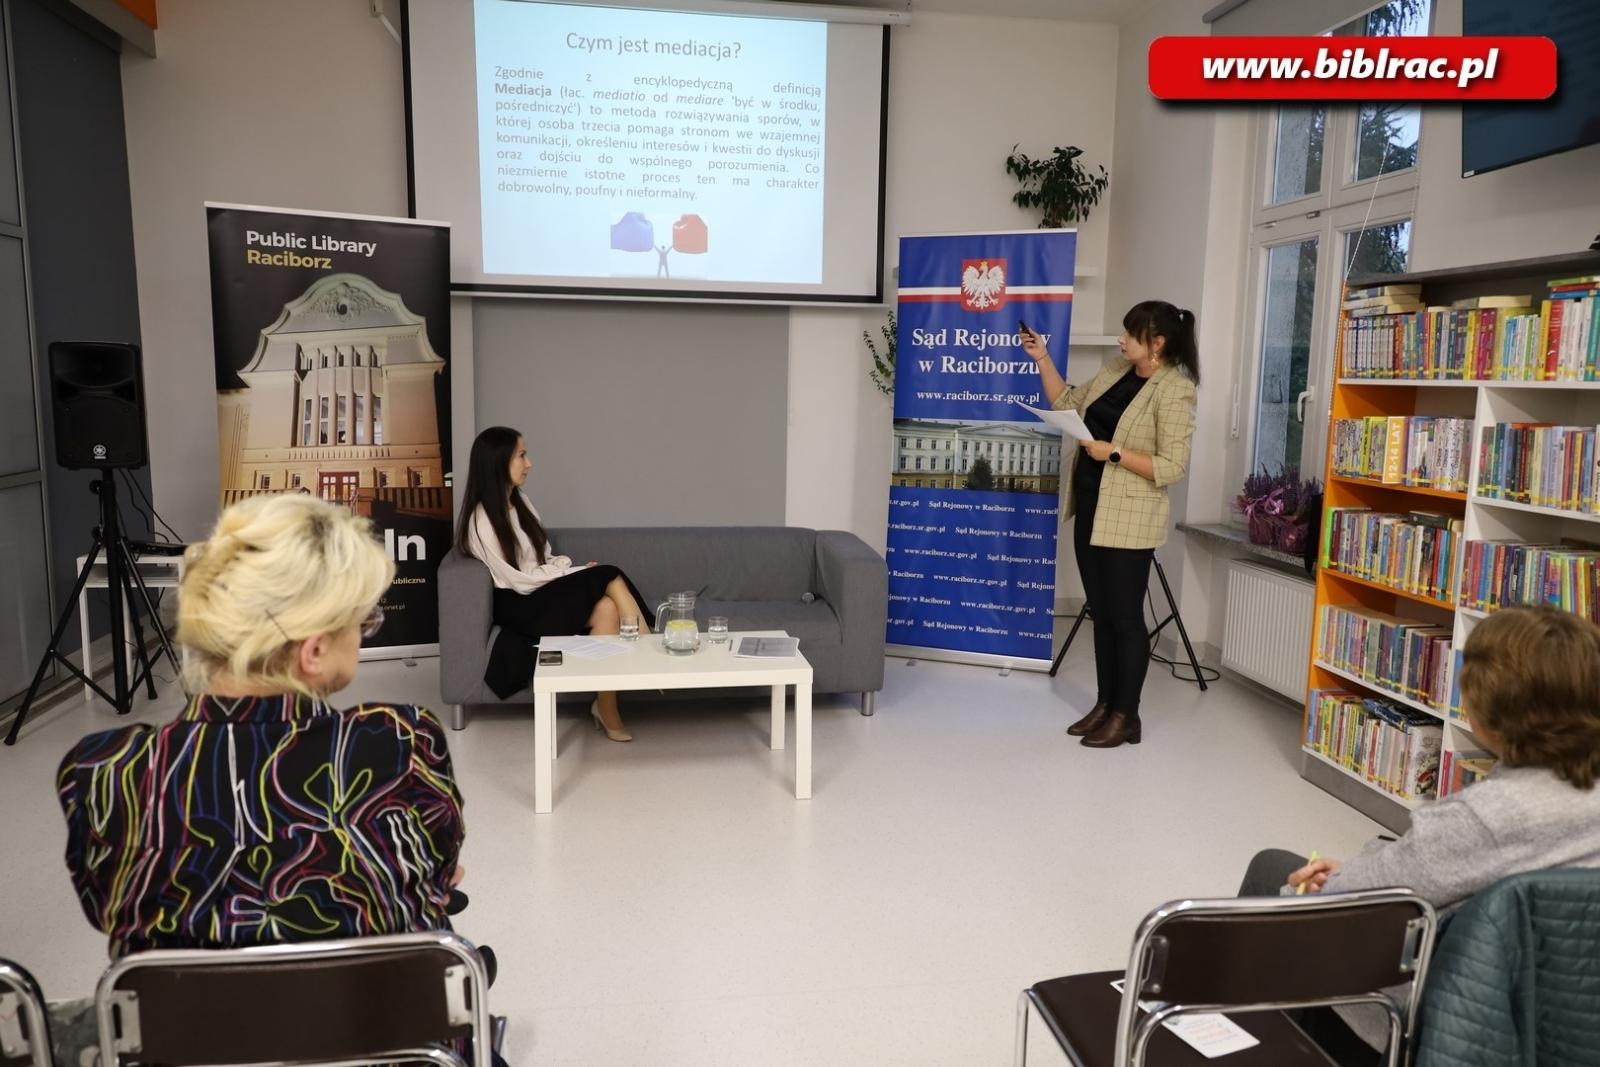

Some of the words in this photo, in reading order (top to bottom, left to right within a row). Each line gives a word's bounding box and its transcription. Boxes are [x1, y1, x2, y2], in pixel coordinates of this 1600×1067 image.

[566, 32, 613, 54] Czym
[617, 35, 649, 55] jest
[654, 39, 742, 62] mediacja?
[495, 65, 544, 80] Zgodnie
[586, 73, 592, 82] z
[633, 75, 733, 91] encyklopedyczną
[772, 82, 821, 98] definicją
[494, 82, 552, 98] Mediacja
[560, 86, 585, 99] (łac.
[593, 89, 646, 102] mediatio
[653, 92, 668, 103] od
[676, 94, 724, 106] mediare
[761, 99, 772, 109] w
[779, 98, 821, 113] środku,
[590, 104, 602, 115] to
[611, 105, 657, 118] metoda
[665, 109, 750, 123] rozwiązywania
[757, 114, 802, 127] sporów,
[810, 117, 821, 127] w
[496, 116, 531, 130] której
[538, 118, 575, 130] osoba
[581, 120, 621, 133] trzecia
[627, 123, 674, 137] pomaga
[681, 126, 730, 138] stronom
[736, 129, 753, 140] we
[759, 130, 821, 145] wzajemnej
[496, 132, 572, 148] komunikacji,
[576, 136, 638, 149] określeniu
[642, 139, 700, 153] interesów
[712, 142, 752, 155] kwestii
[756, 145, 772, 156] do
[775, 146, 820, 161] dyskusji
[496, 150, 523, 161] oraz
[539, 150, 582, 164] dojściu
[597, 153, 614, 164] do
[629, 156, 693, 169] wspólnego
[708, 158, 789, 173] porozumienia.
[804, 163, 820, 174] Co
[497, 165, 568, 179] niezmiernie
[584, 168, 626, 181] istotne
[642, 172, 681, 184] proces
[697, 174, 716, 185] ten
[732, 177, 751, 187] ma
[766, 177, 819, 189] charakter
[497, 181, 573, 196] dobrowolny,
[575, 184, 617, 198] poufny
[626, 186, 698, 200] nieformalny.
[246, 230, 308, 249] Public
[311, 235, 377, 257] Library
[247, 249, 332, 269] Raciborz
[911, 328, 947, 349] Sąd
[953, 328, 1052, 350] Rejonoy
[918, 359, 935, 373] w
[940, 355, 1041, 375] Raciborzu
[916, 391, 1040, 405] www.raciborz.sr.gov.pl
[1391, 423, 1401, 445] LAT
[929, 501, 941, 509] Sąd
[942, 502, 973, 511] Rejonowy
[982, 503, 1016, 513] Raciborzu
[955, 526, 968, 535] Sąd
[969, 528, 1000, 538] Rejonowy
[1009, 530, 1042, 540] Raciborzu
[904, 548, 977, 560] www.raciborz.sr.gov.pl
[1001, 554, 1033, 565] Rejonowy
[392, 577, 427, 585] ubliczna
[893, 570, 924, 579] Raciborzu
[933, 574, 1008, 587] www.raciborz.sr.gov.pl
[1017, 581, 1030, 590] Sąd
[888, 594, 911, 603] jonowy
[919, 596, 951, 606] Raciborzu
[960, 601, 1036, 614] www.raciborz.sr.gov.pl
[936, 621, 967, 632] Rejonowy
[975, 626, 1009, 636] Raciborzu
